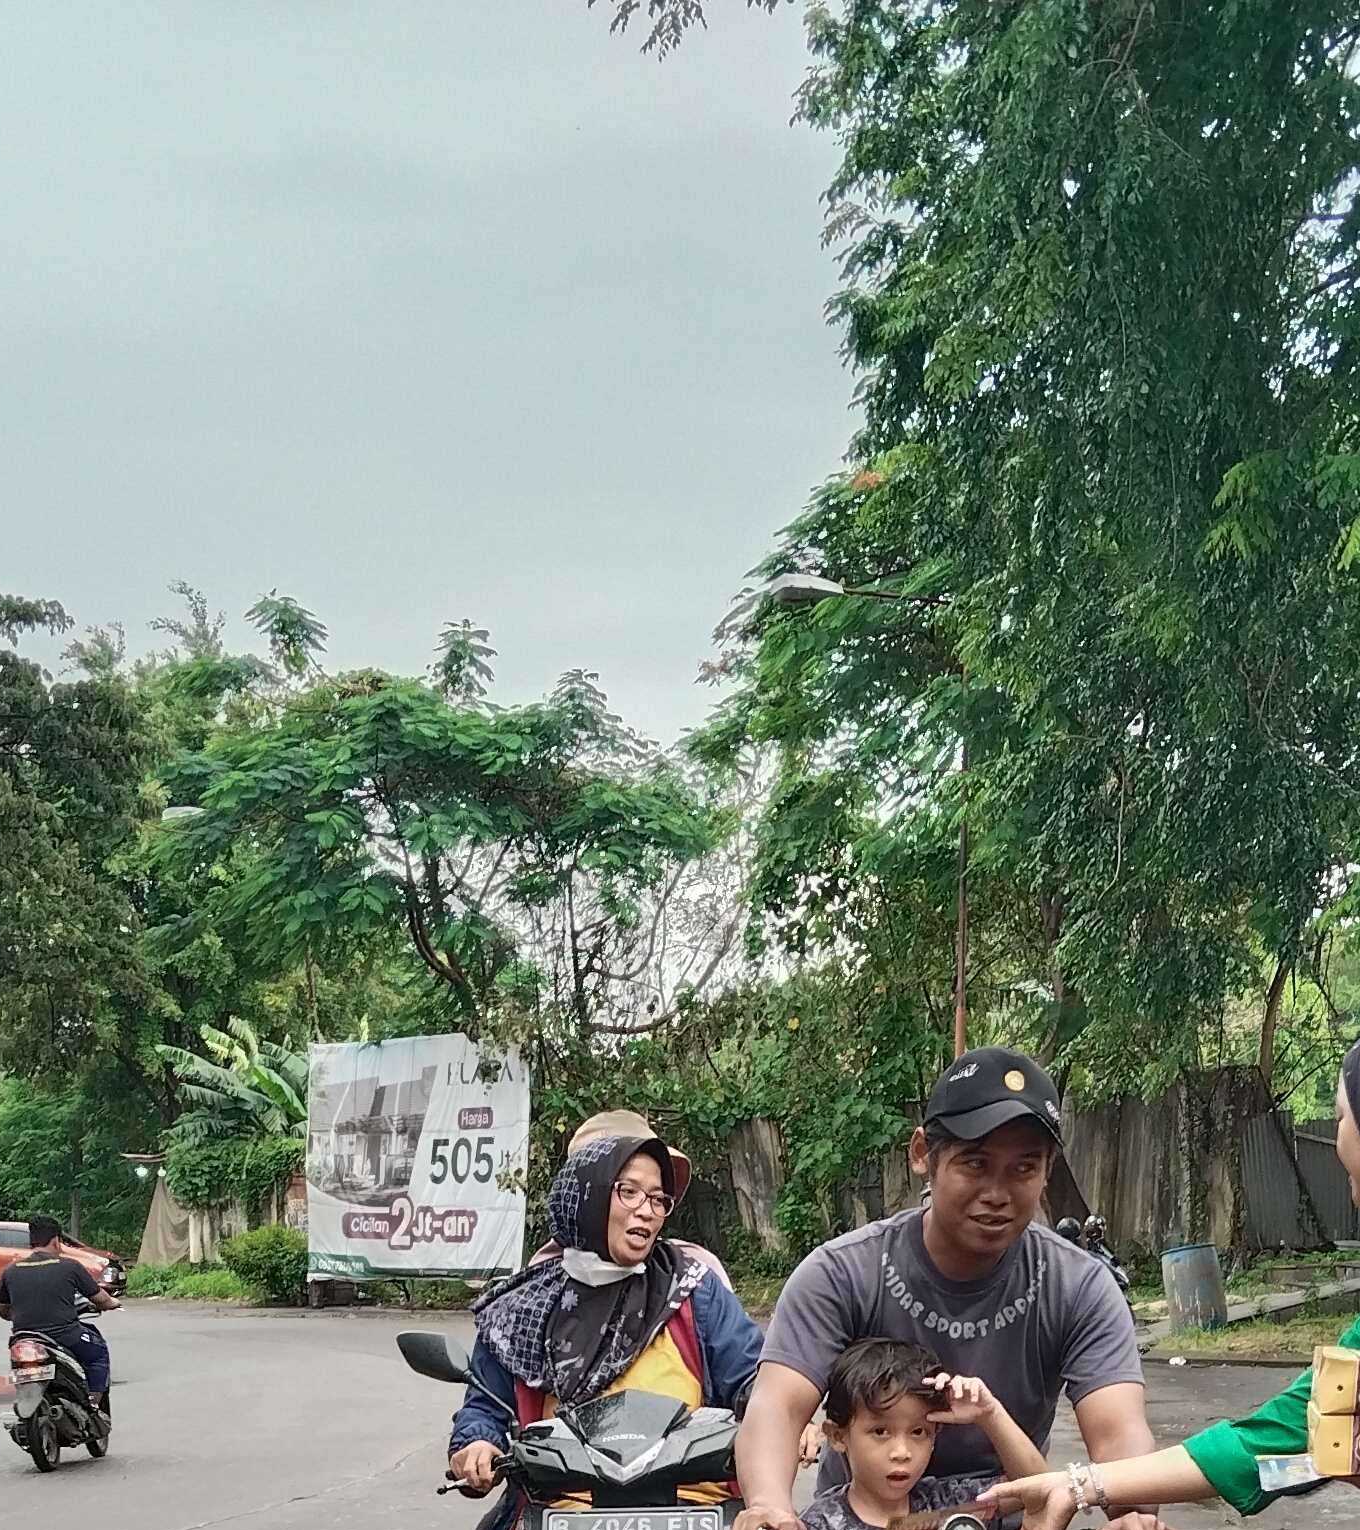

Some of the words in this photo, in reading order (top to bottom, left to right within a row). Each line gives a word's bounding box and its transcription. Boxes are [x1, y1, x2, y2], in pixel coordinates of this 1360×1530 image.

[461, 1110, 490, 1128] Harga
[429, 1136, 496, 1185] 505
[350, 1214, 389, 1234] Cicilan
[391, 1197, 413, 1246] 2
[924, 1311, 990, 1339] SPORT
